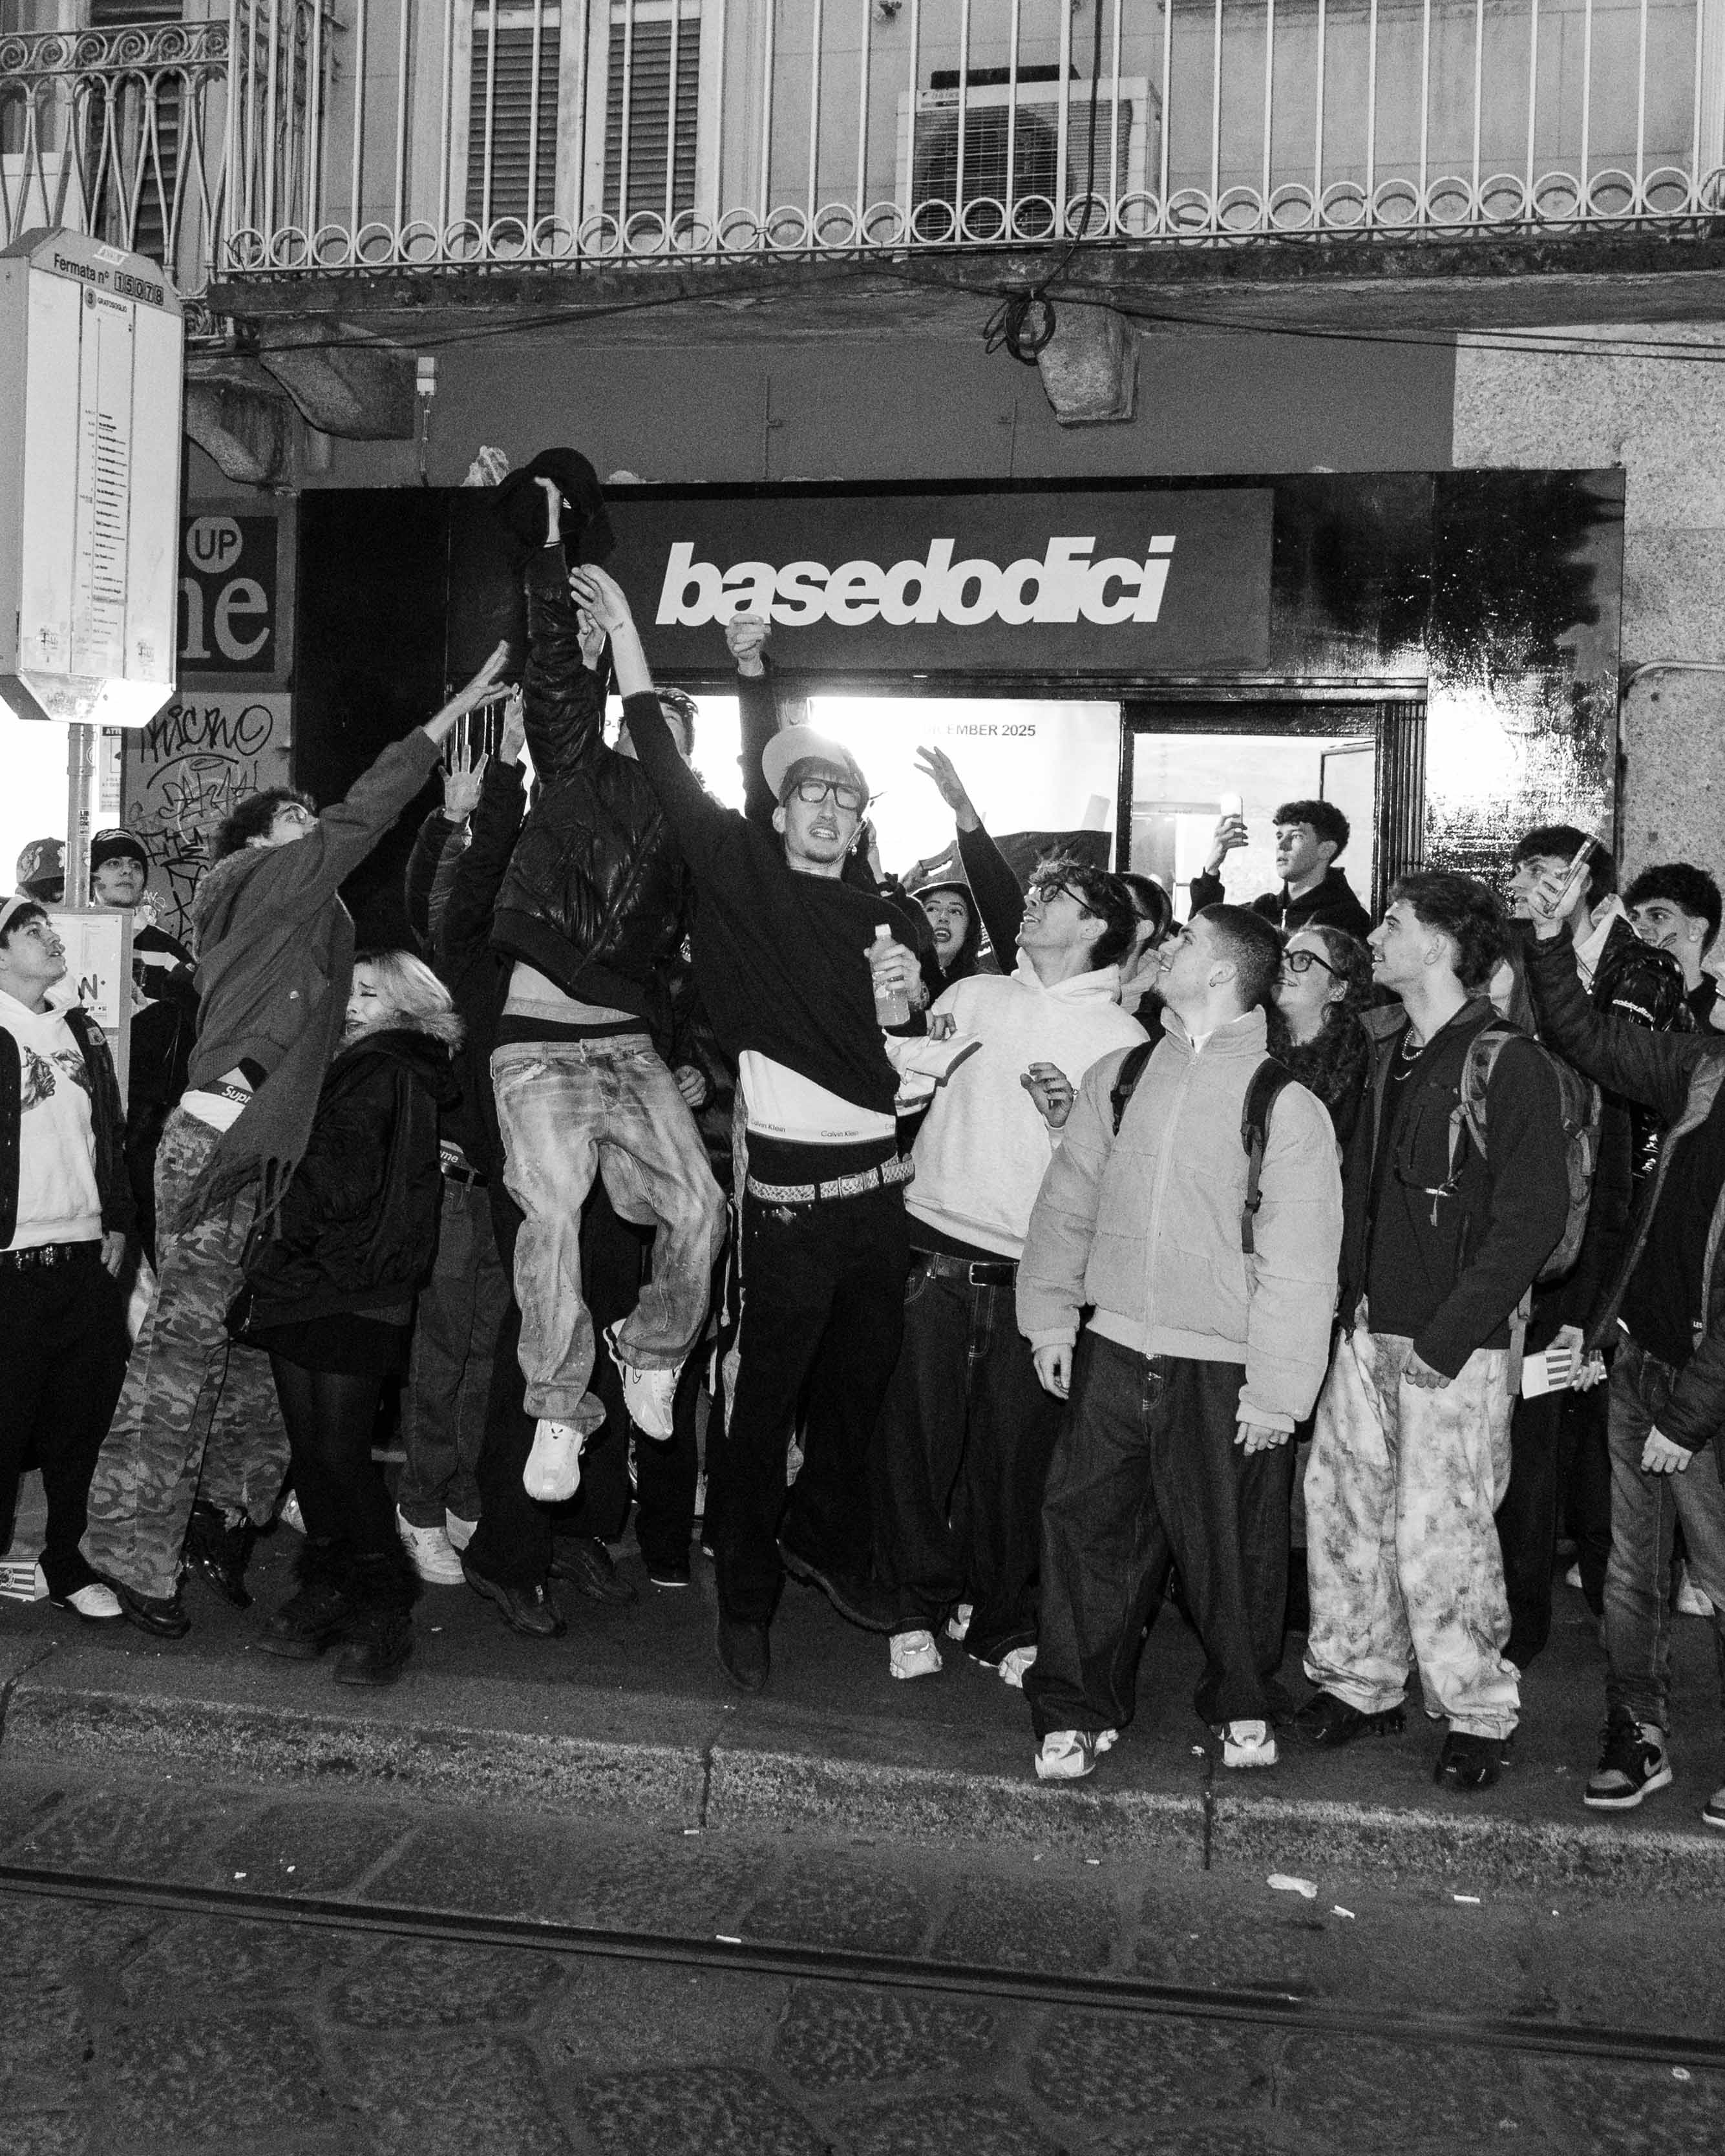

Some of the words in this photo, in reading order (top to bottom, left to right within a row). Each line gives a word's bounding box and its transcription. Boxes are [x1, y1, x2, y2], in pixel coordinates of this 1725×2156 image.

[54, 253, 96, 281] Fermata
[117, 275, 162, 303] 15078
[87, 292, 94, 305] 3
[195, 529, 237, 560] UP
[655, 535, 1176, 627] basedodici
[1001, 724, 1037, 737] 2025
[440, 1150, 459, 1163] me
